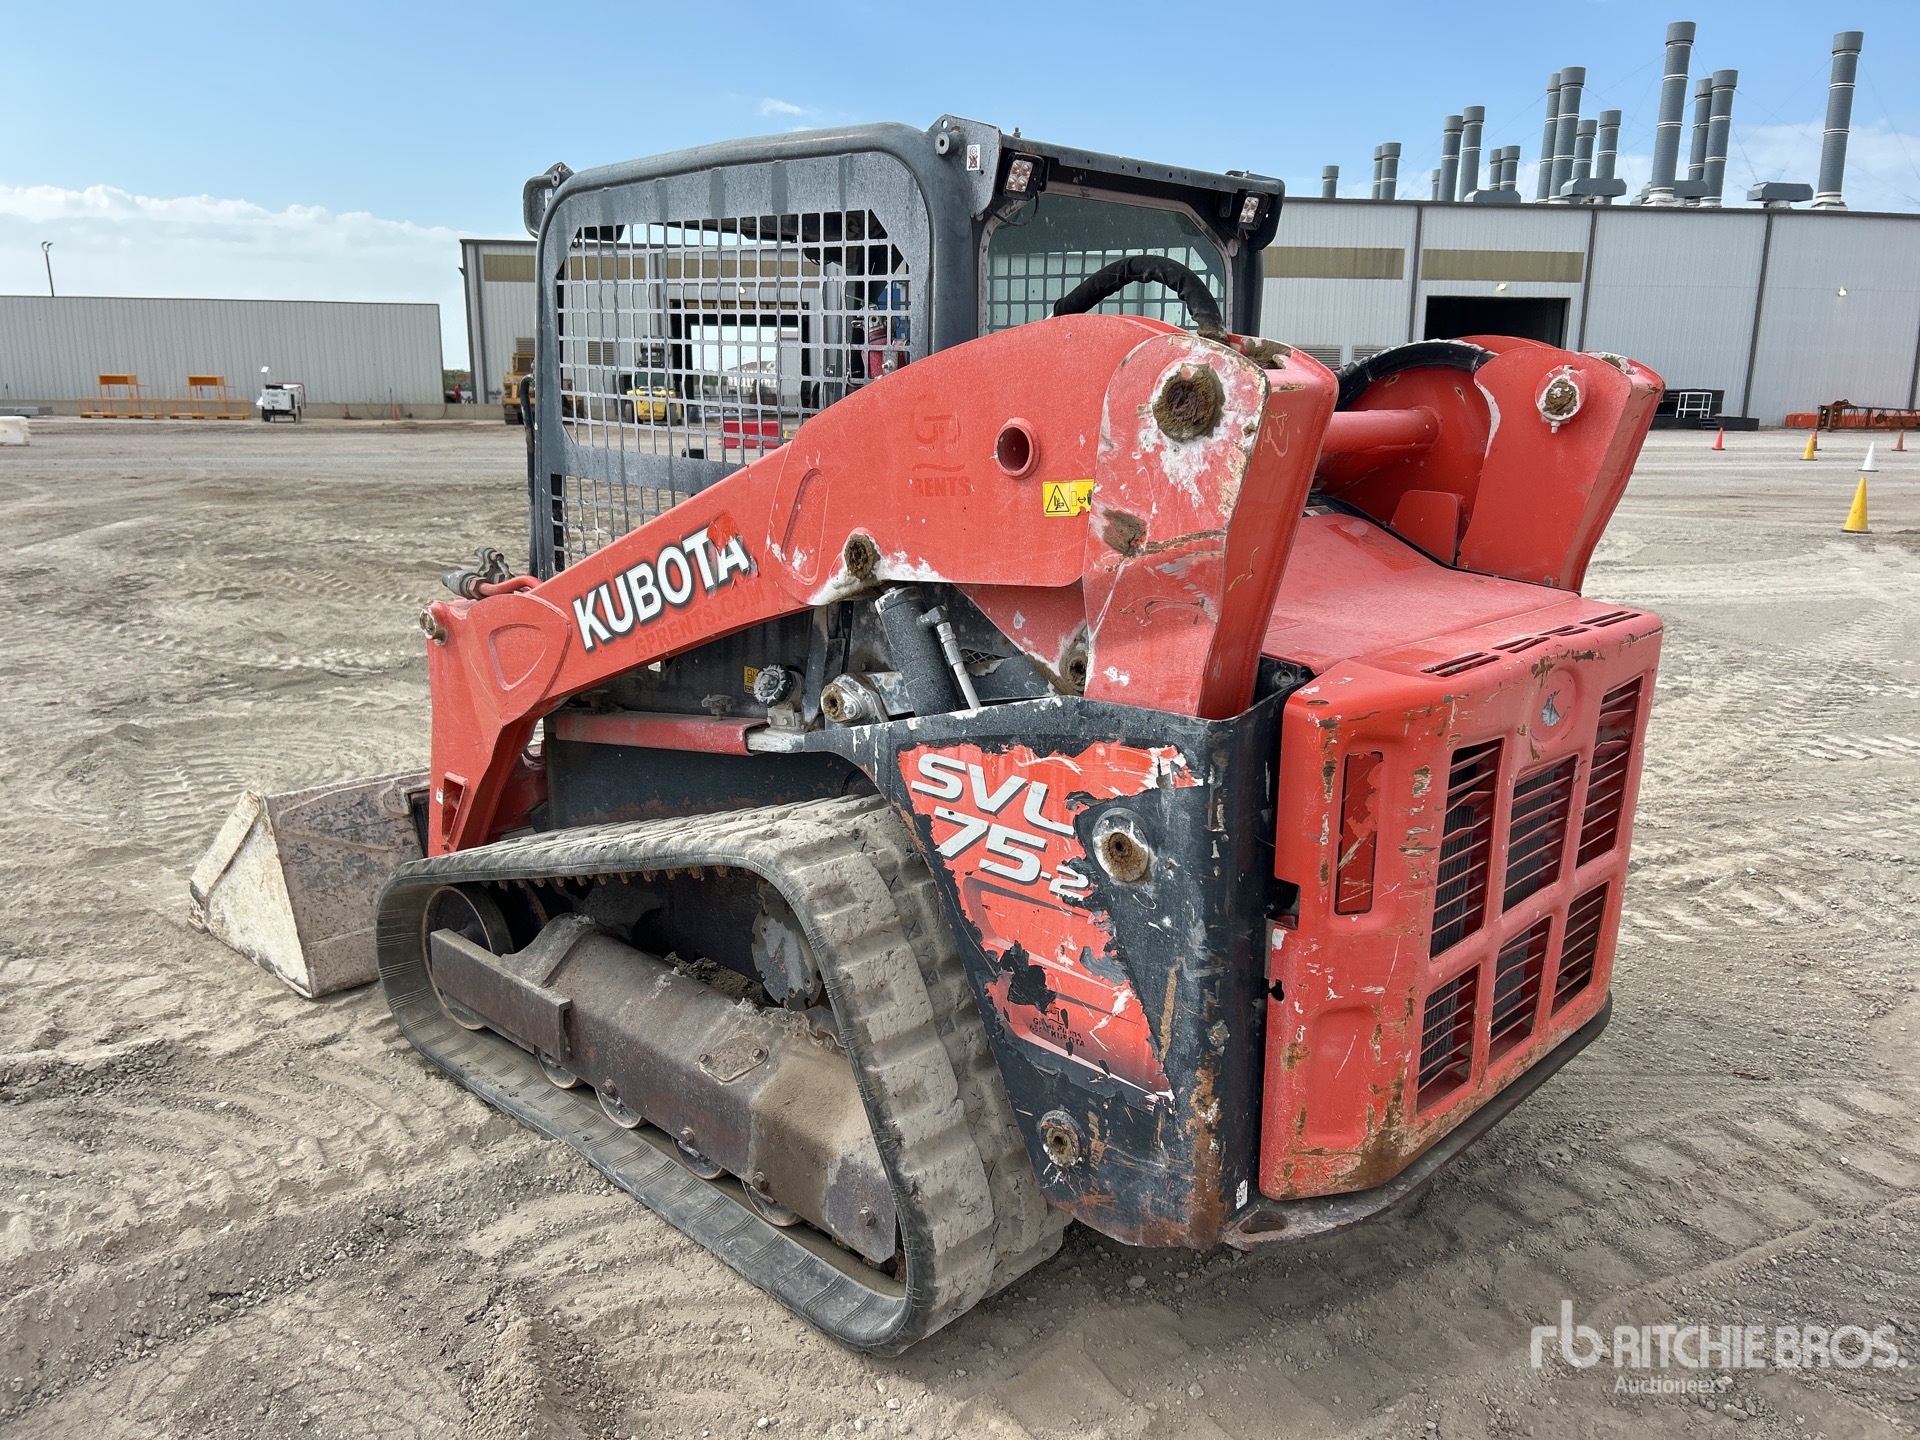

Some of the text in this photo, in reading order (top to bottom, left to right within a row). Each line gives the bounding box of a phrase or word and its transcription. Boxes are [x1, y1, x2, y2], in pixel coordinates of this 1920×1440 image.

[572, 526, 751, 651] KUBOTA
[910, 753, 1075, 838] SVL
[934, 806, 1090, 901] 75-2
